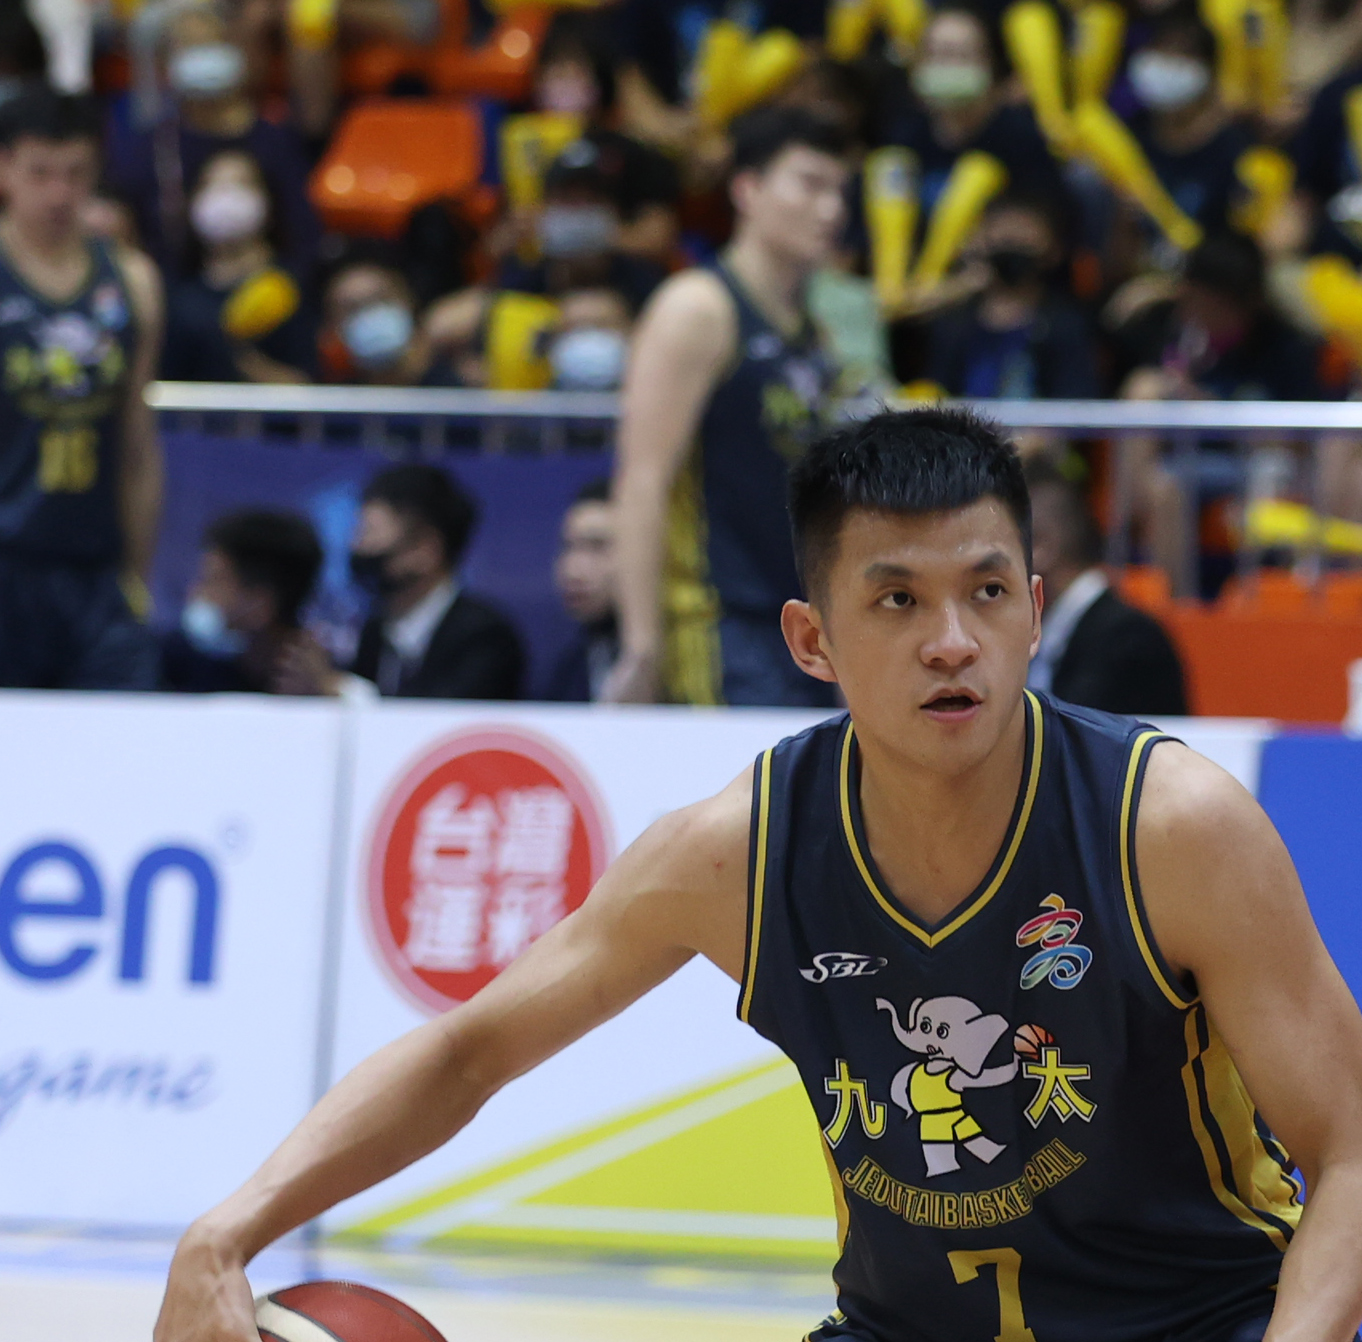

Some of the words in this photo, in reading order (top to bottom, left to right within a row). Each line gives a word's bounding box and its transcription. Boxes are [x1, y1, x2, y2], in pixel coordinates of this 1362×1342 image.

[823, 1057, 888, 1150] 九
[1022, 1047, 1098, 1129] 太
[842, 1137, 1087, 1229] JEOUTAIBASKEBALL
